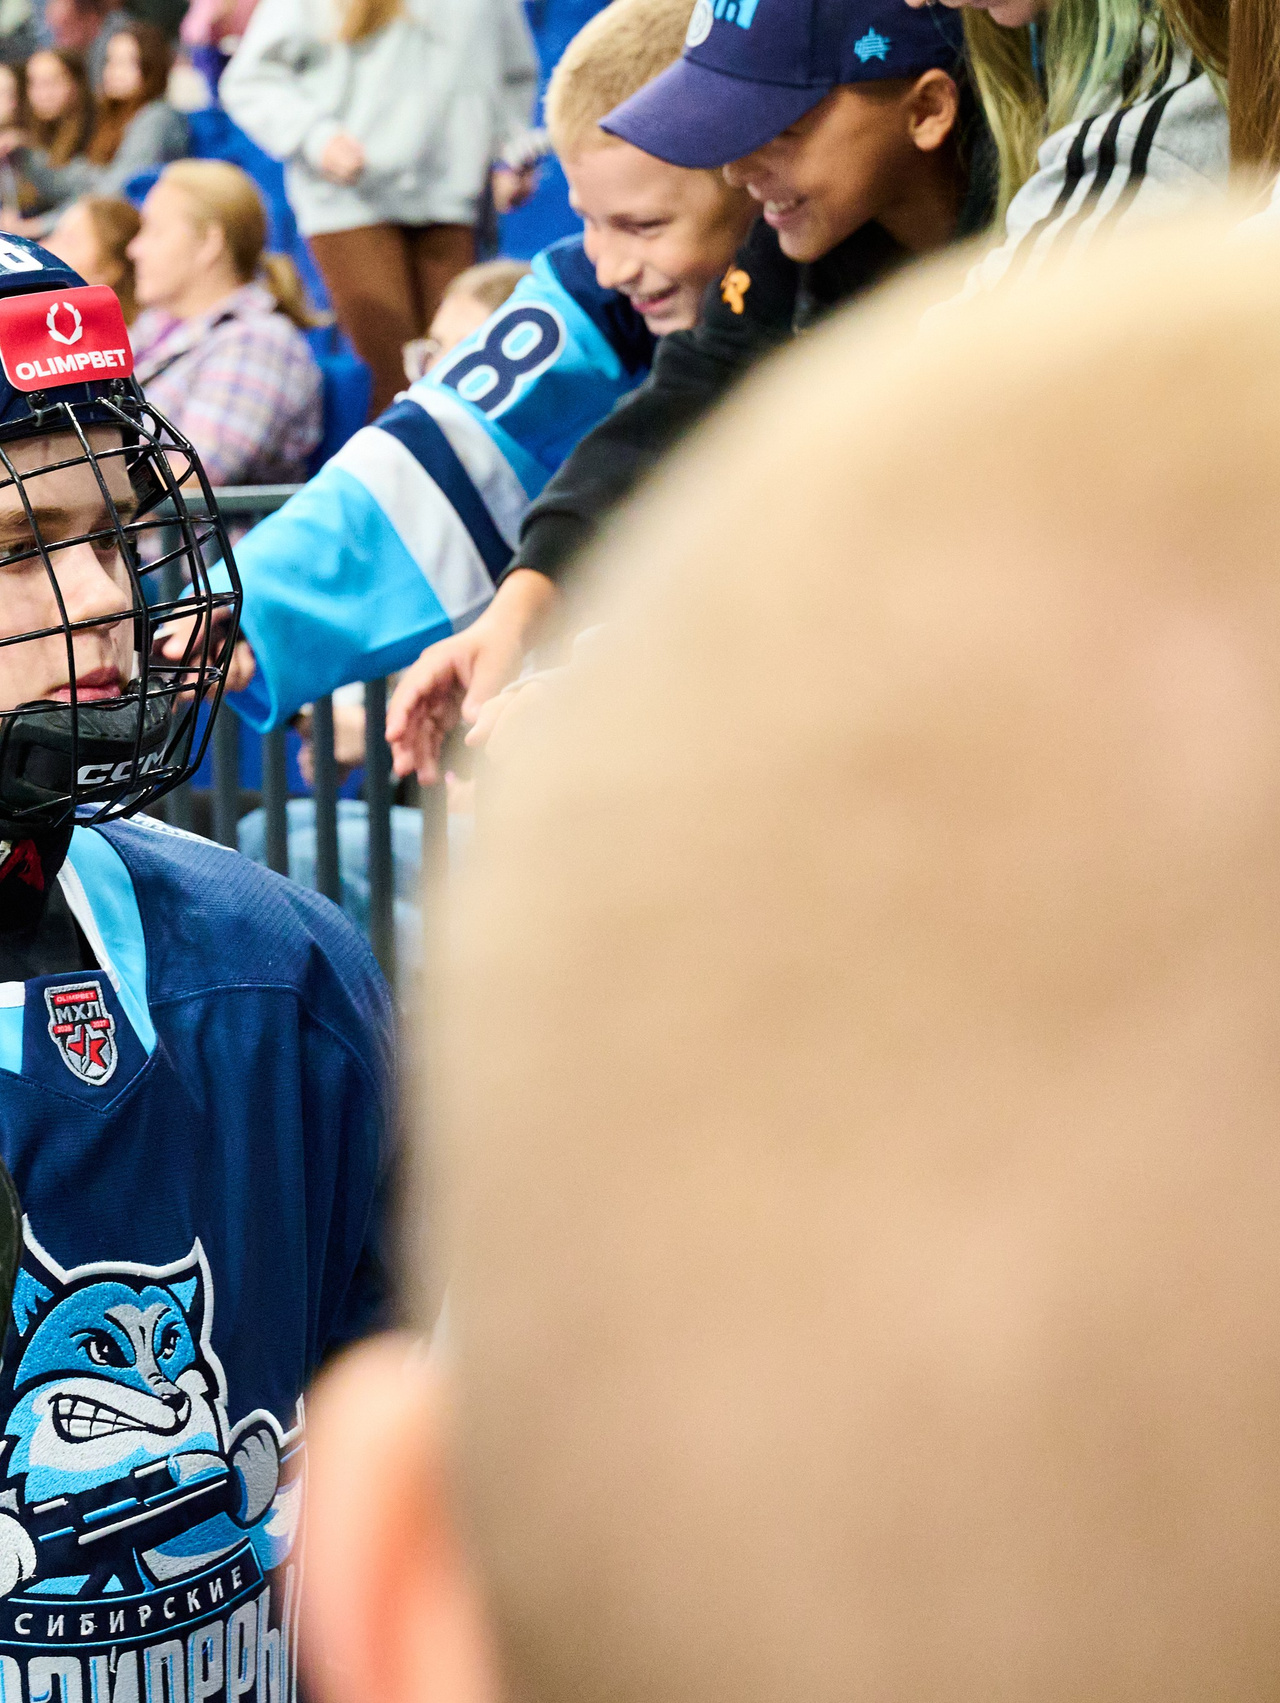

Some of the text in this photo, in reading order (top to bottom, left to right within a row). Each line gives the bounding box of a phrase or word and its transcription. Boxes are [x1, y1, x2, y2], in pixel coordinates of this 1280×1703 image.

[16, 349, 125, 380] OLIMPBET
[434, 301, 567, 421] 8
[77, 750, 167, 785] CCM
[55, 1001, 101, 1024] МХЛ
[56, 992, 94, 1003] OLIMPBET
[14, 1565, 243, 1637] СИБИРСКИЕ
